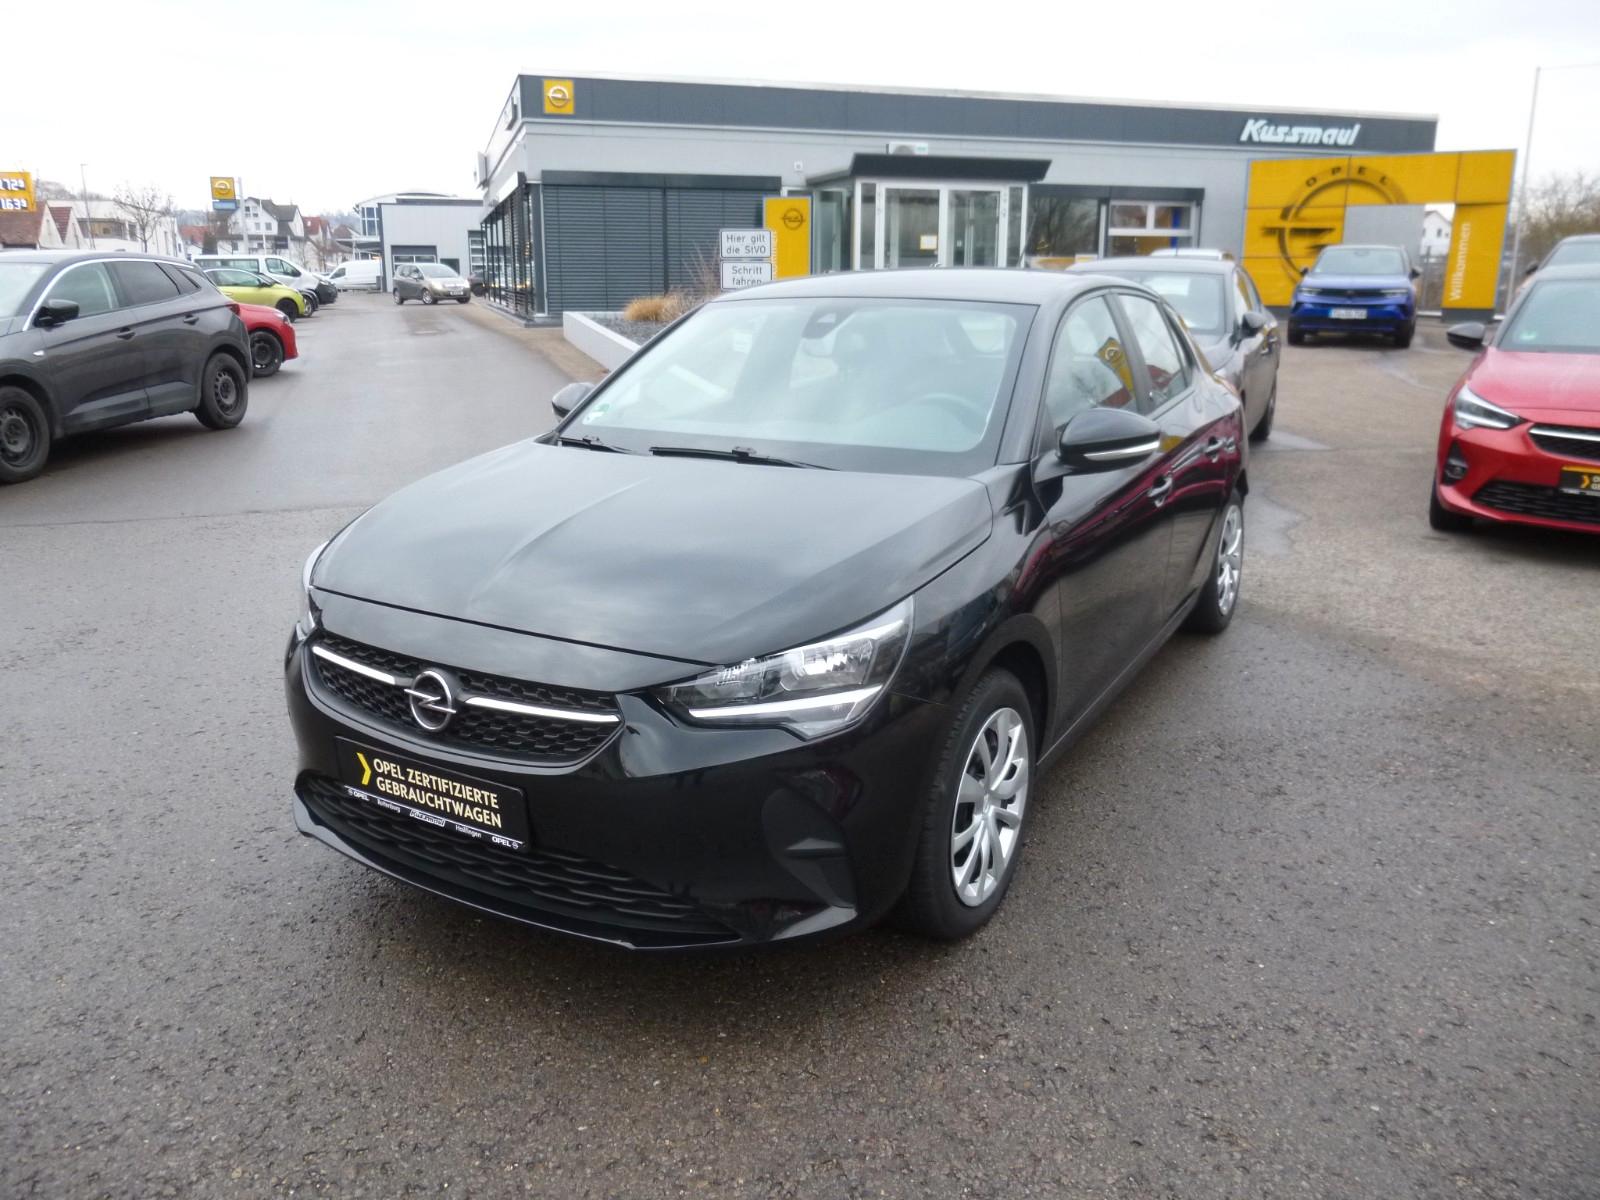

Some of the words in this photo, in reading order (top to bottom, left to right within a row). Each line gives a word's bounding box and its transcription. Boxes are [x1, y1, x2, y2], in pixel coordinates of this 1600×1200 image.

[1240, 119, 1361, 145] Kussmaul
[1305, 165, 1389, 188] OPEL
[726, 234, 746, 243] Hier
[751, 234, 766, 245] gilt
[726, 245, 740, 254] die
[731, 265, 762, 275] Schritt
[1449, 223, 1471, 301] Willkommen
[732, 276, 762, 285] fahren
[373, 758, 405, 780] OPEL
[406, 768, 499, 809] ZERTIFIZIERTE
[376, 777, 502, 828] GEBRAUCHTWAGEN
[491, 835, 511, 848] OPEL
